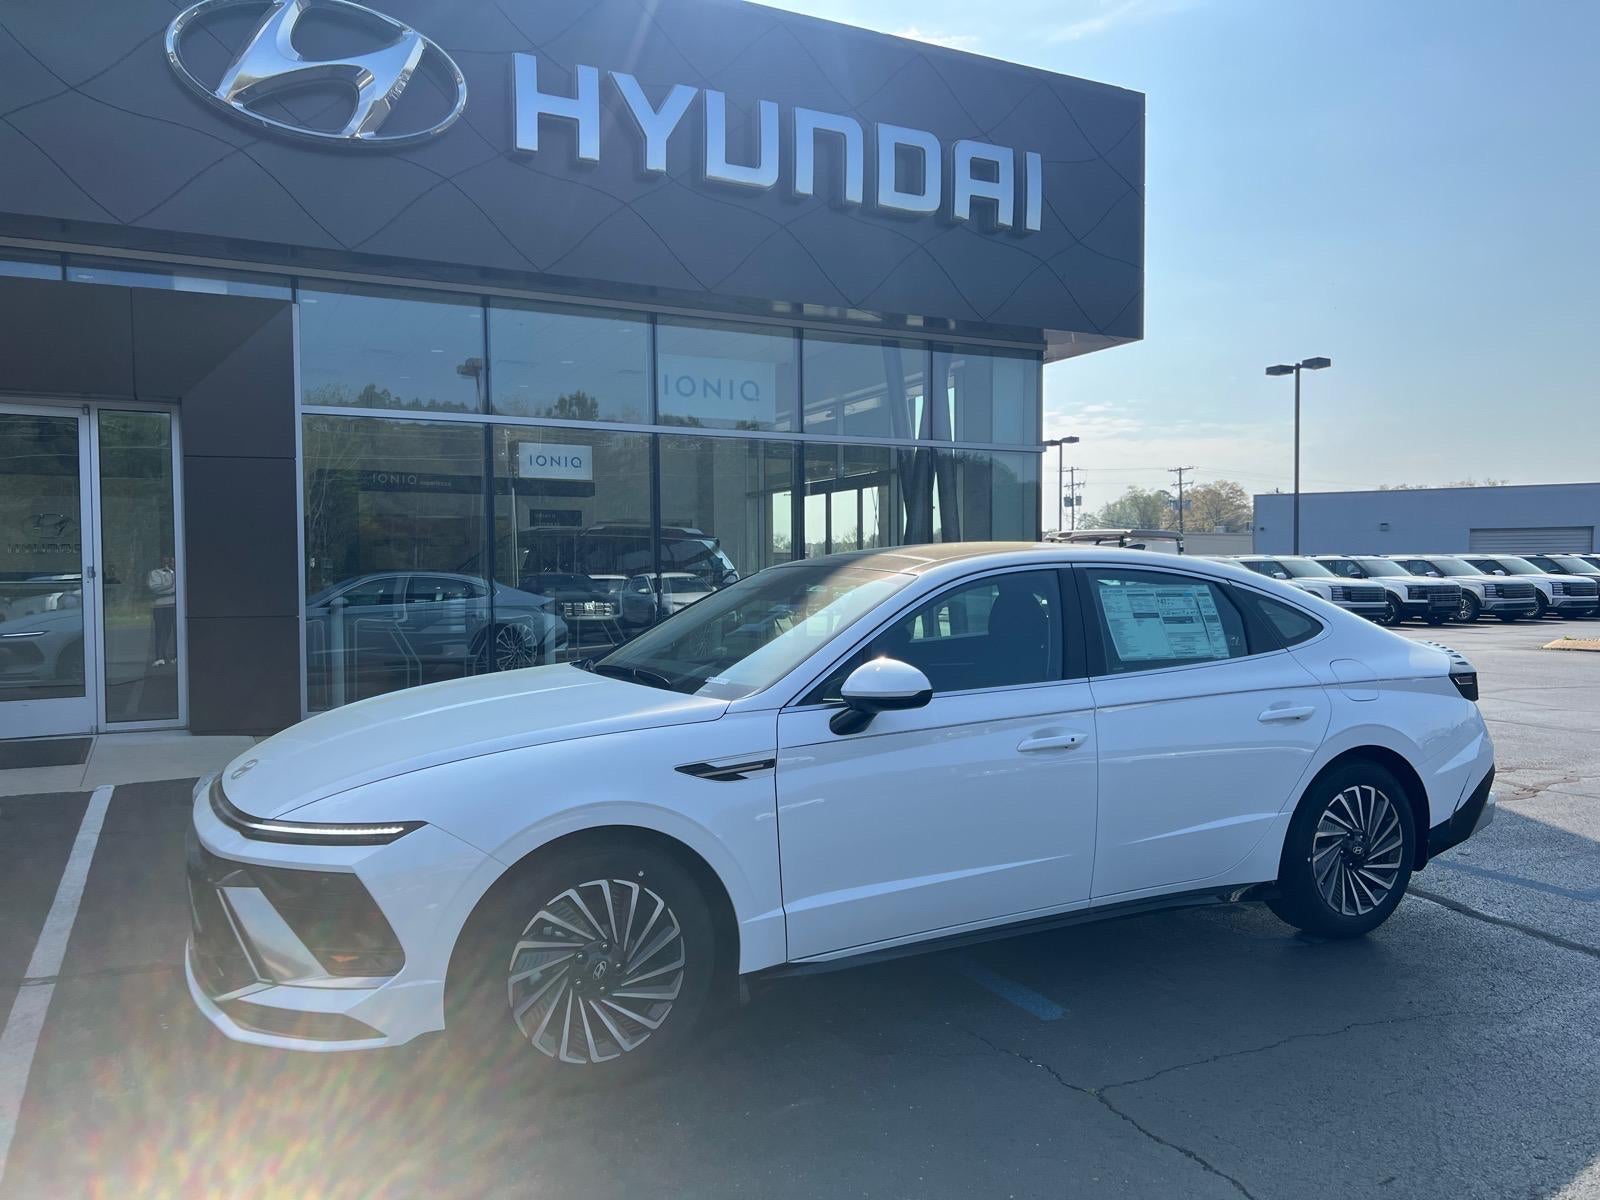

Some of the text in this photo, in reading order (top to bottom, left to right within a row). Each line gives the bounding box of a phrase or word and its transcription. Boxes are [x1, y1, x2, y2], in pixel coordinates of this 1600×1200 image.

[512, 52, 1042, 232] HYUNDAI
[664, 374, 760, 401] IONIQ
[529, 454, 582, 469] IONIQ
[372, 473, 417, 485] IONIQ
